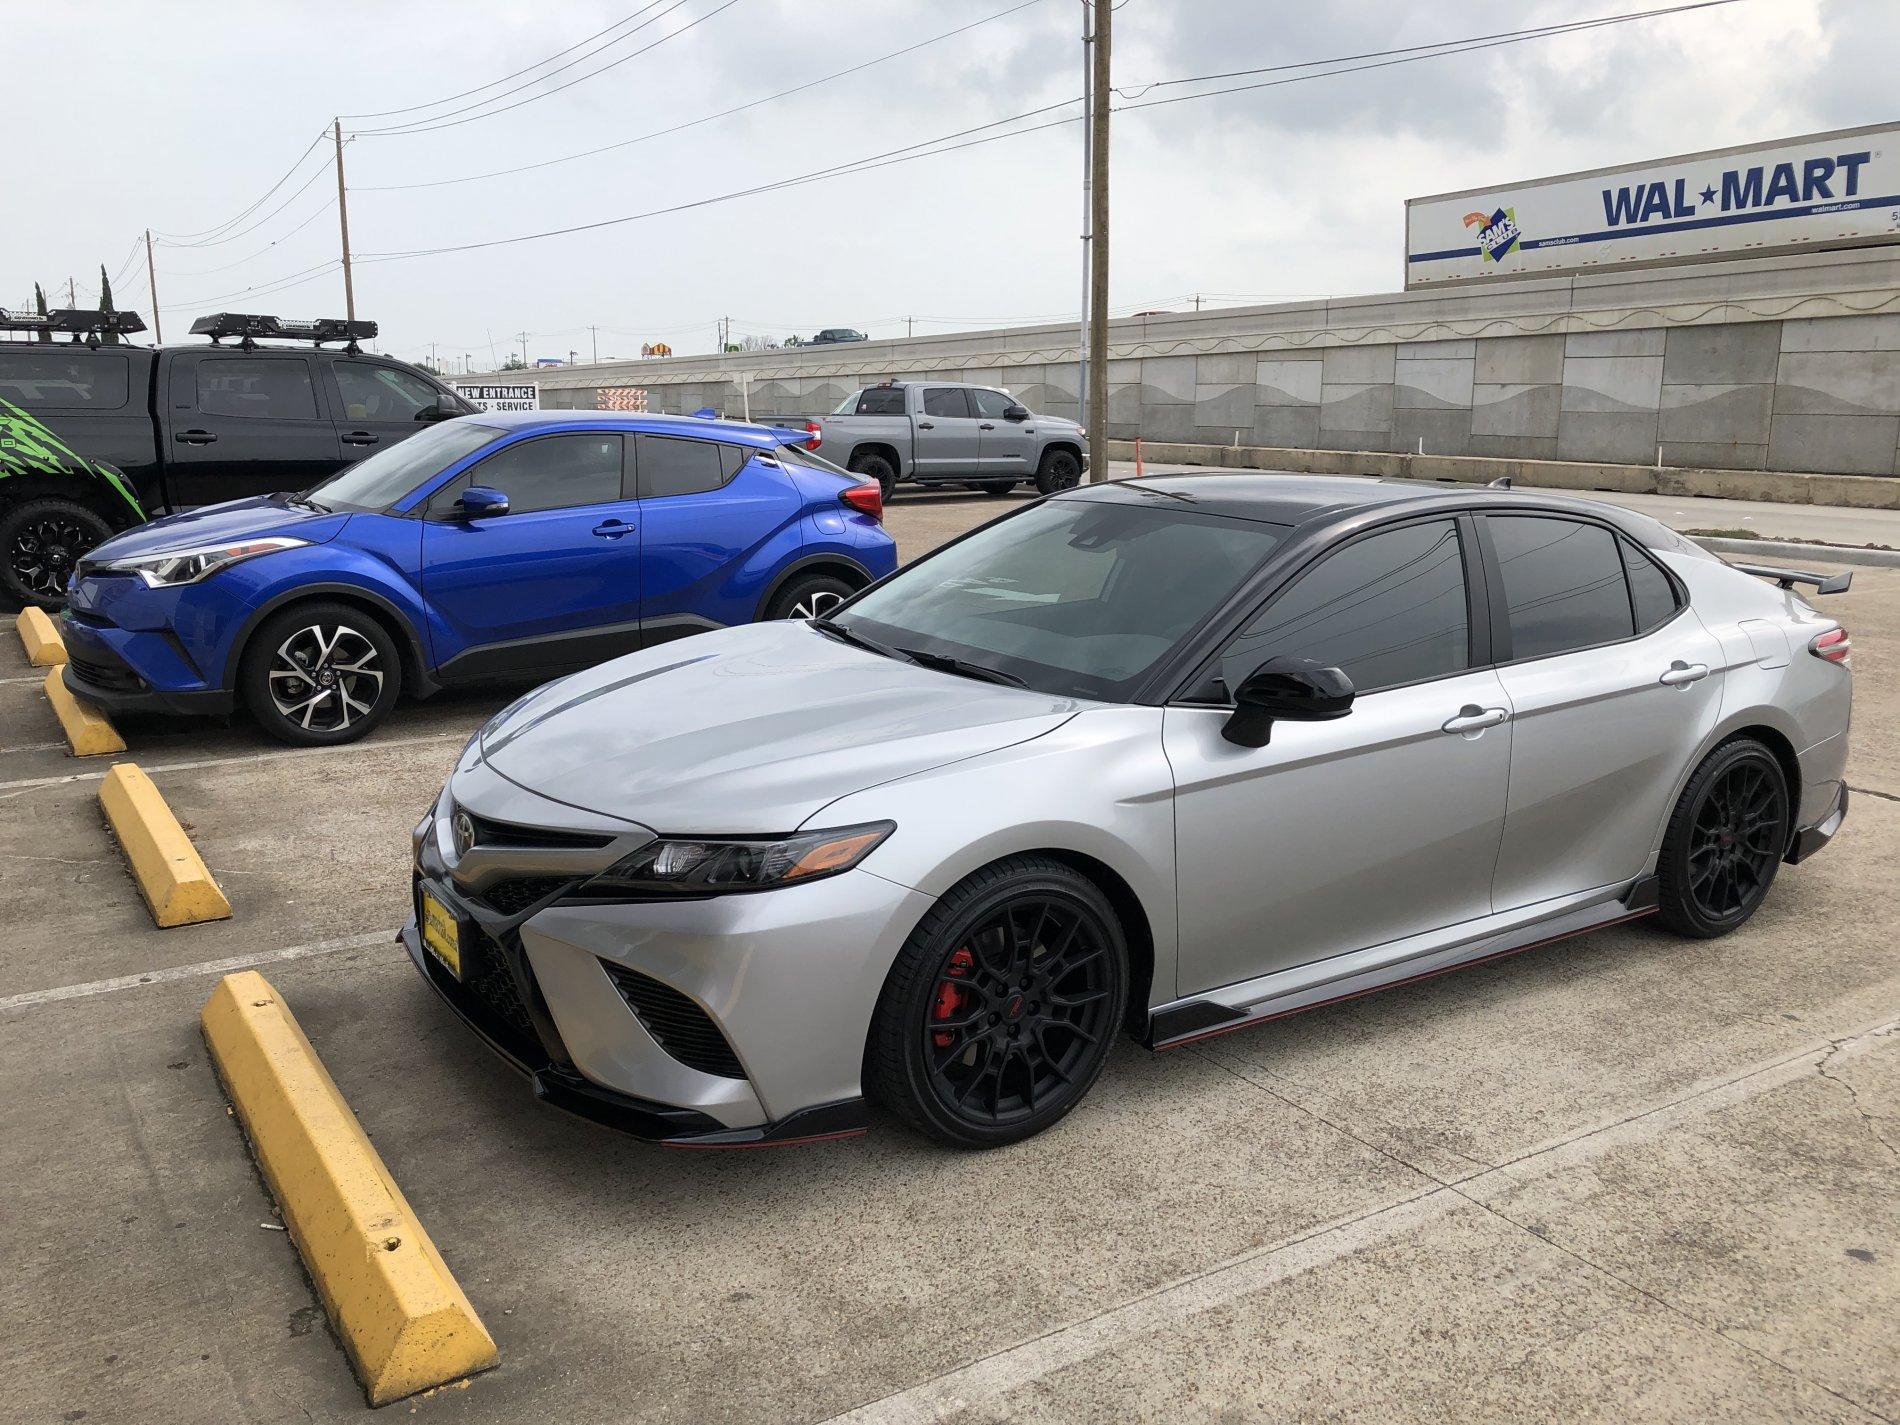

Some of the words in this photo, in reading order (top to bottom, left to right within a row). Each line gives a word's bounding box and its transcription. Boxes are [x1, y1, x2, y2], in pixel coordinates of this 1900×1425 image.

[1602, 178, 1696, 227] WAL
[1720, 151, 1871, 212] MART
[1811, 202, 1861, 213] walmart.com
[1477, 216, 1516, 246] SAM'S
[1486, 227, 1518, 251] CLUB
[1538, 237, 1580, 247] samsclub.com
[458, 387, 480, 399] NEW
[483, 387, 534, 399] ENTRANCE
[497, 402, 533, 411] SERVICE
